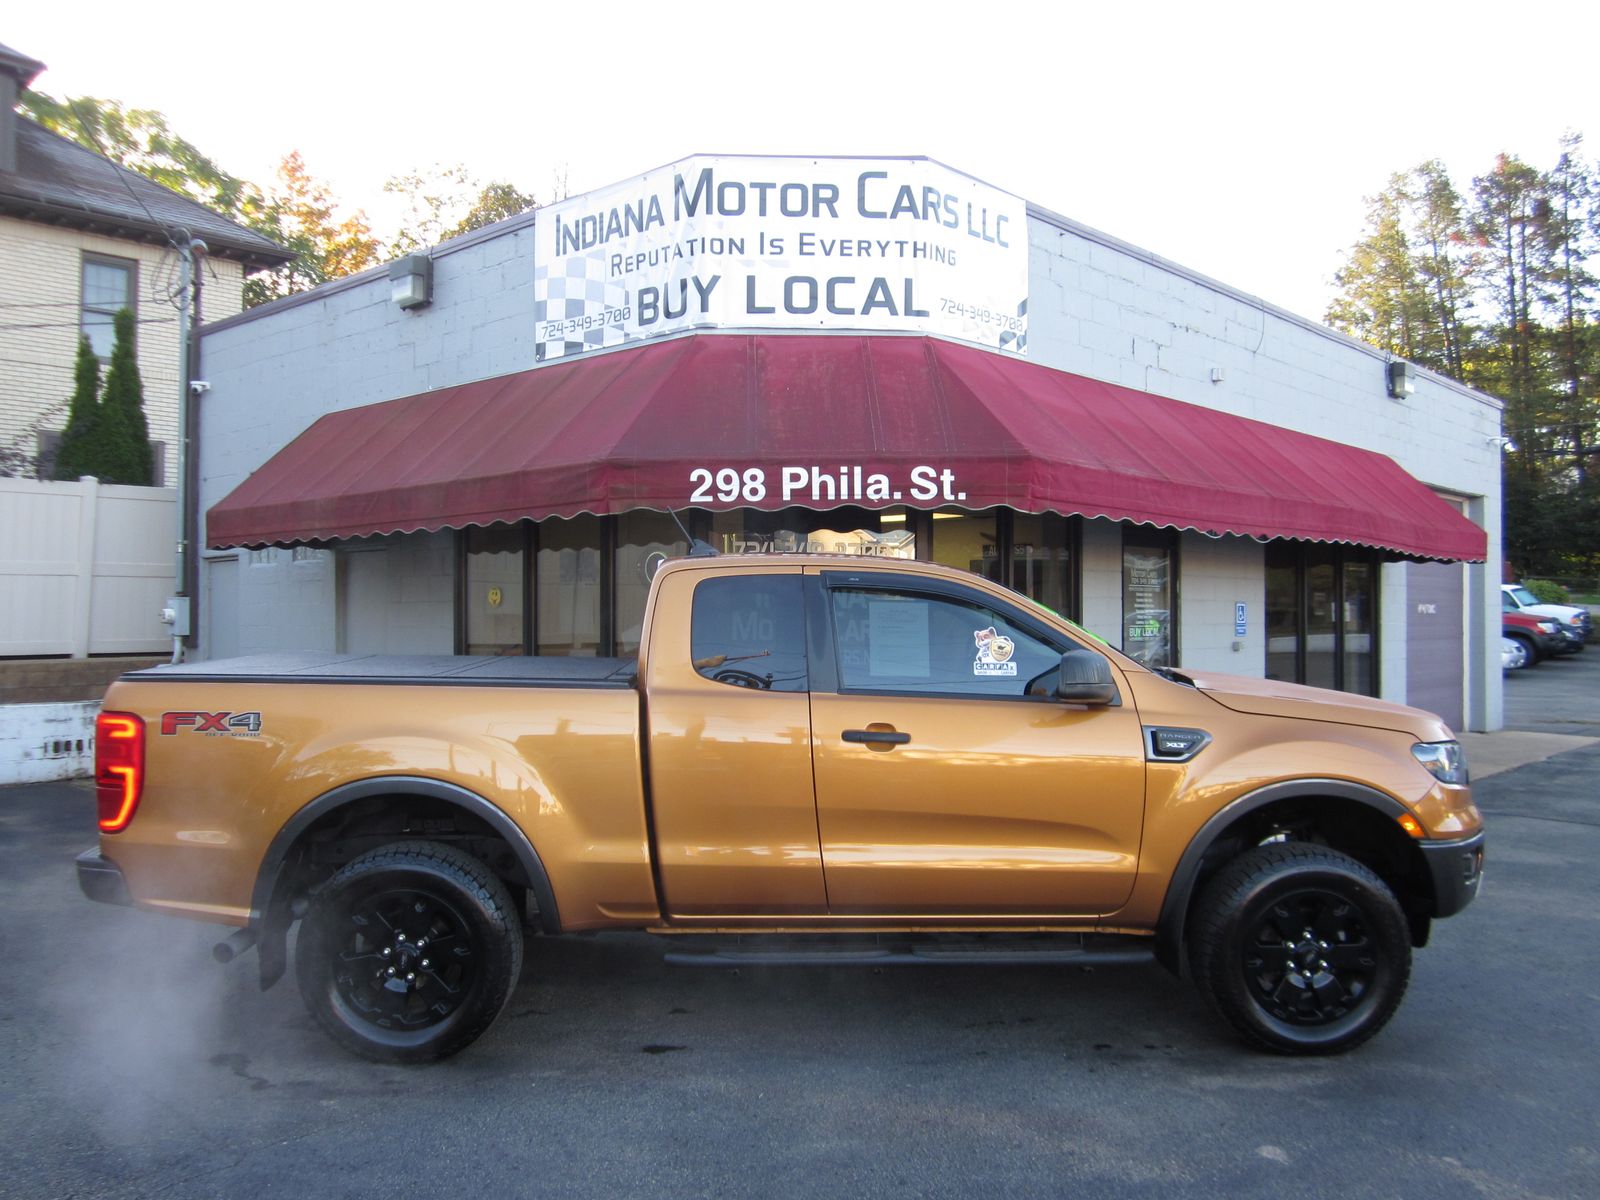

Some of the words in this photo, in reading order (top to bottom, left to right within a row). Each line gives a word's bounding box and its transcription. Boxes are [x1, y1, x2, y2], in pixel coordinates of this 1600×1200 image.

[556, 195, 665, 257] INDIANA
[674, 168, 840, 222] MOTOR
[857, 171, 960, 230] CARS
[967, 202, 1010, 249] LLC
[610, 236, 745, 277] REPUTATION
[759, 232, 785, 255] IS
[799, 232, 957, 267] EVERYTHING
[637, 275, 722, 327] BUY
[746, 275, 930, 318] LOCAL
[541, 307, 631, 340] 724-349-3700
[689, 467, 767, 503] 298
[782, 465, 902, 501] Phila.
[910, 465, 967, 501] St.
[976, 663, 1015, 671] CARFAX
[160, 711, 262, 736] FX4
[1166, 741, 1189, 749] XLT
